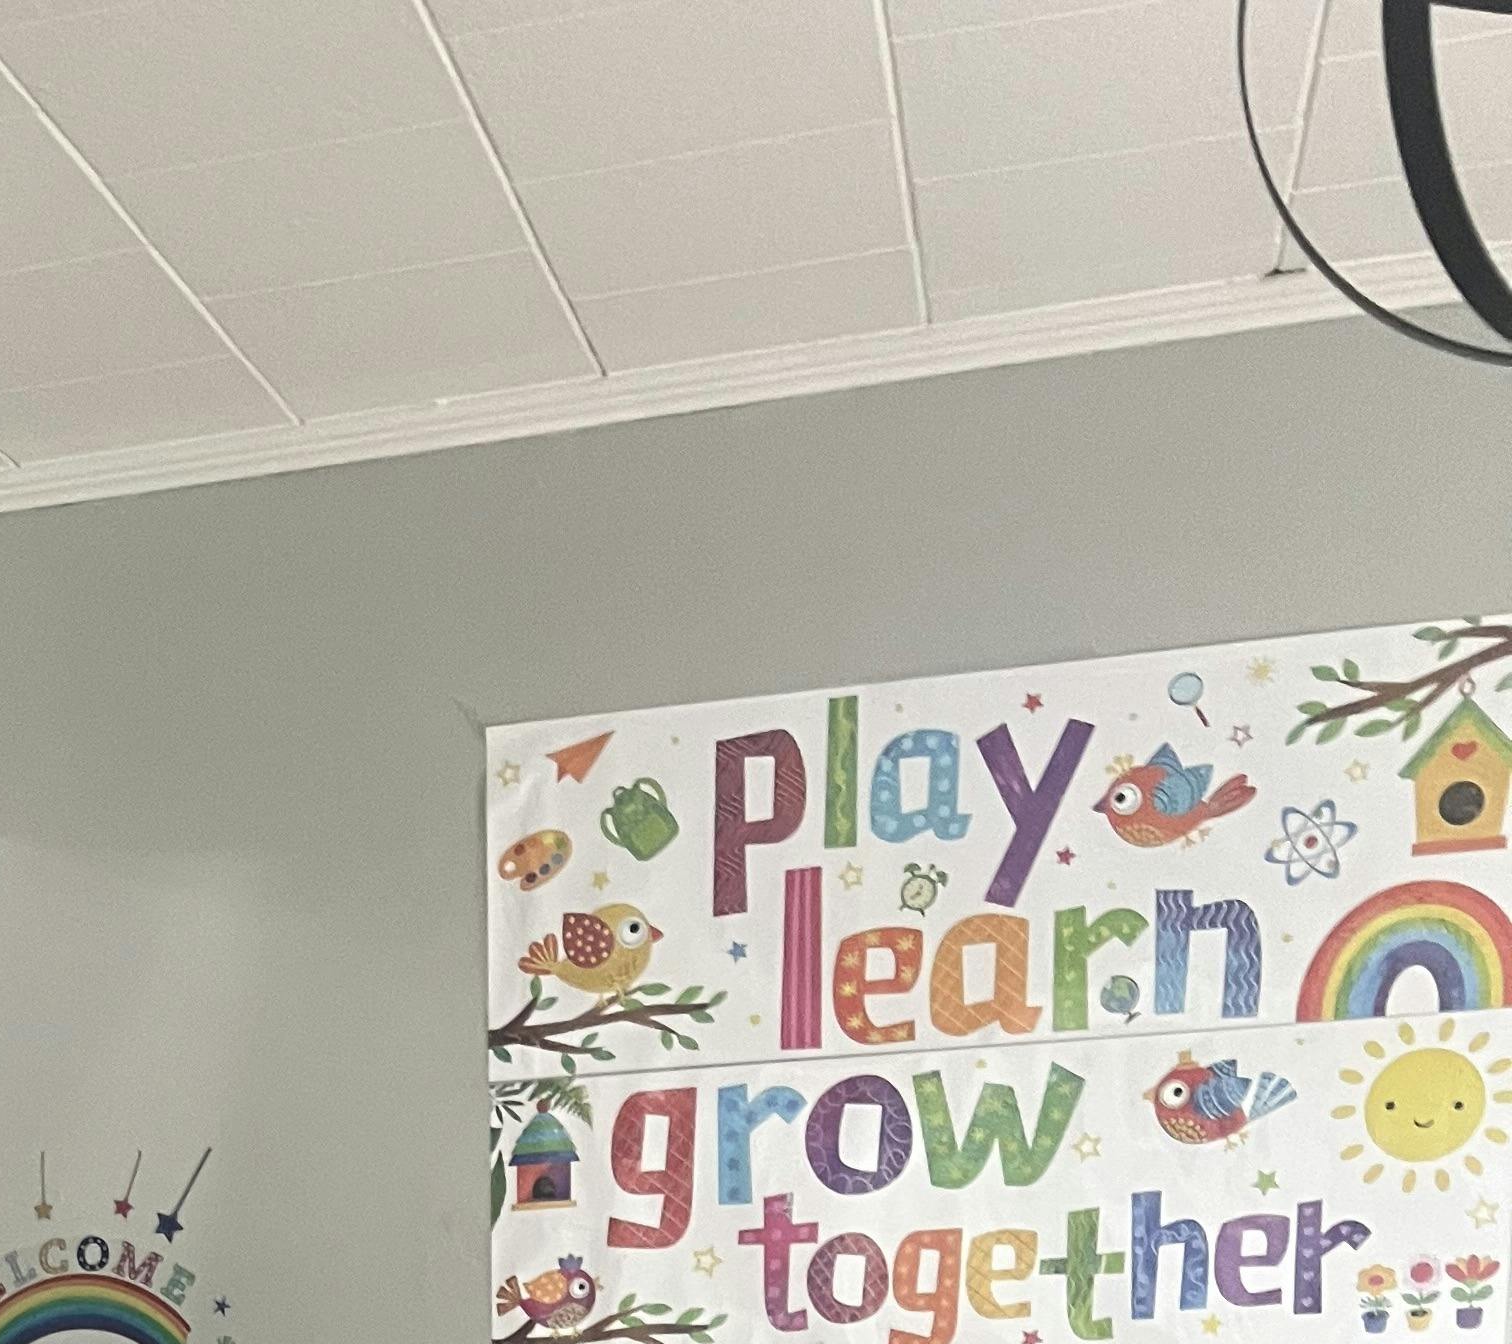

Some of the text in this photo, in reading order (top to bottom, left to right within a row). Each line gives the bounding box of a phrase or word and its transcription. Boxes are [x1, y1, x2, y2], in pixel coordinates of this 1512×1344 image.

[713, 695, 1094, 916] play
[780, 866, 1261, 1050] learn
[606, 1061, 1086, 1250] grow
